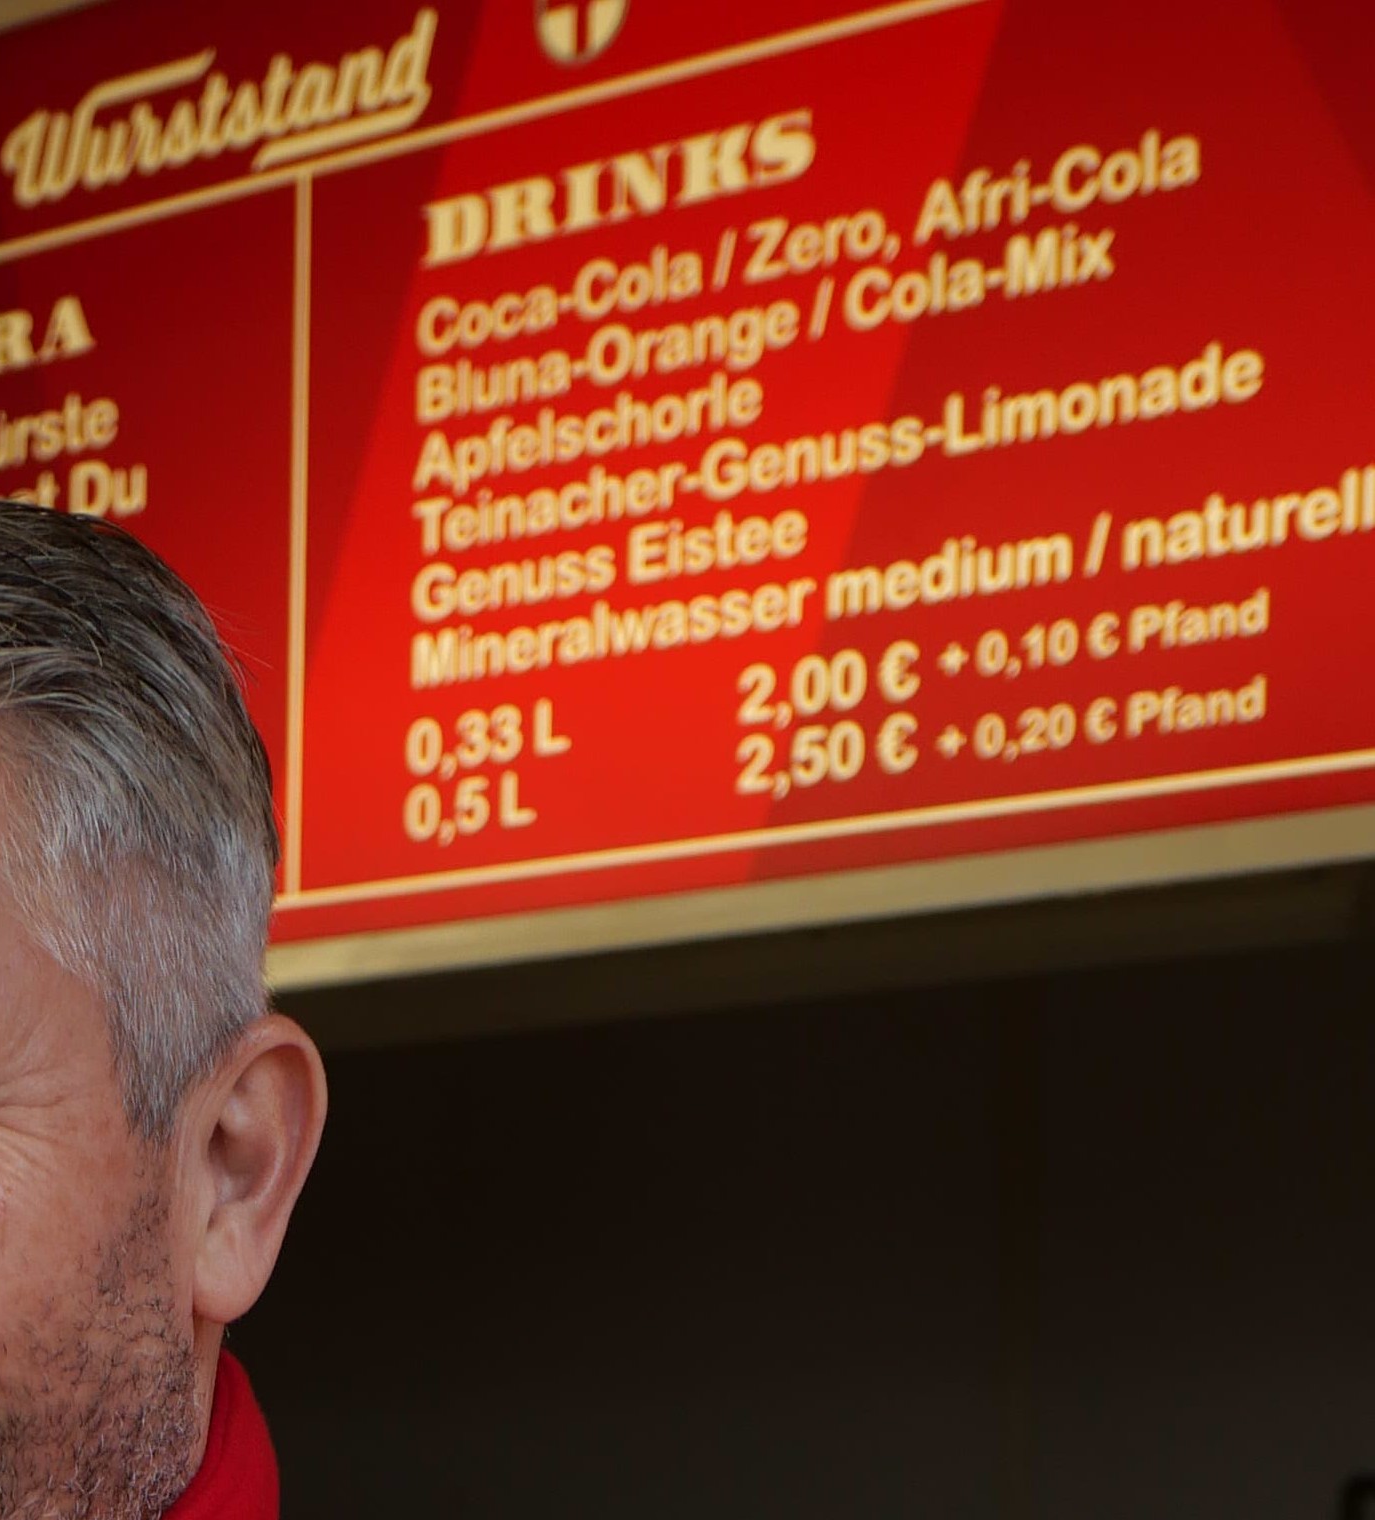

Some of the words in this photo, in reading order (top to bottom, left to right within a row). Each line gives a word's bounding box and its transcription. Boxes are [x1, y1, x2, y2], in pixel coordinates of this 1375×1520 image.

[0, 6, 436, 207] Wurststand
[415, 243, 703, 356] Coca-Cola
[711, 227, 738, 293] /
[742, 208, 901, 285] Zero,
[914, 127, 1202, 246] Afri-Cola
[421, 106, 816, 271] DRINKS
[415, 299, 801, 425] Bluna-Orange
[807, 275, 834, 342] /
[843, 222, 1116, 331] Cola-Mix
[67, 459, 148, 517] Du
[411, 340, 1266, 556] Teinacher-Genuss-Limonade
[412, 370, 764, 495] Apfelschorle
[410, 544, 617, 622] Genuss
[627, 509, 809, 585] Eistee
[410, 576, 818, 690] Mineralwasser
[825, 532, 1074, 619] medium
[1083, 511, 1113, 578] /
[1120, 464, 1375, 571] naturell
[736, 649, 868, 729] 2,00
[878, 640, 921, 702] €
[975, 619, 1079, 680] 0,10
[1086, 612, 1121, 659] €
[1128, 587, 1271, 653] Pfand
[404, 704, 524, 781] 0,33
[532, 697, 572, 758] L
[735, 720, 866, 800] 2,50
[876, 712, 918, 775] €
[973, 702, 1077, 763] 0,20
[1084, 697, 1118, 743] €
[1125, 674, 1268, 738] Pfand
[403, 774, 490, 847] 0,5
[498, 770, 538, 829] L
